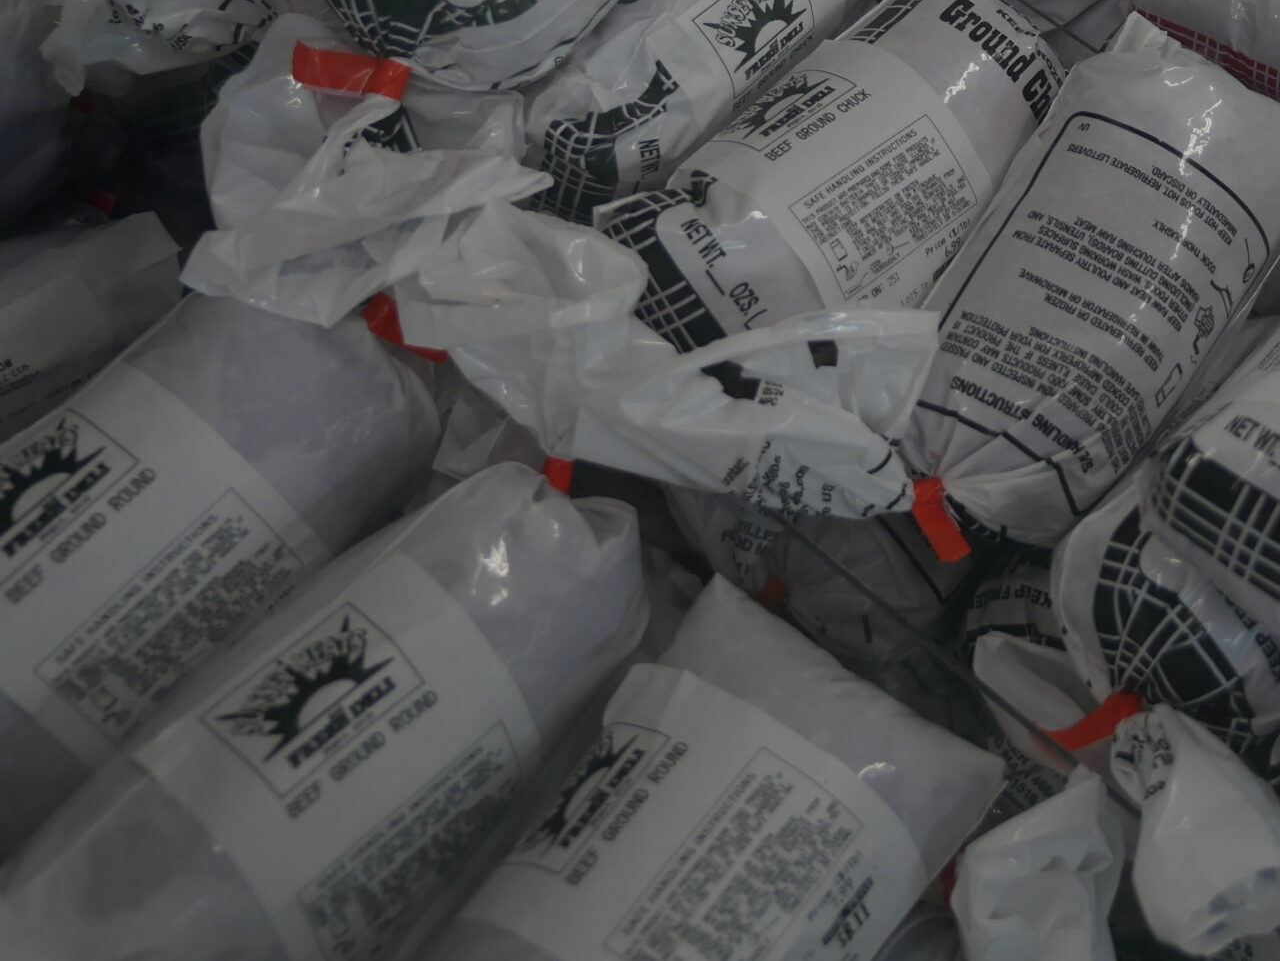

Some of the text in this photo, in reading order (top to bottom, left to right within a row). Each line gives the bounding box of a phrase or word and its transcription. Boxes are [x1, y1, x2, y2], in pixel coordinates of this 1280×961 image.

[764, 85, 872, 164] BEEF GROUND CHUCK
[637, 137, 662, 161] NET
[803, 124, 919, 210] SAFE HANDLING INSTRUCTIONS
[1066, 134, 1235, 245] KEEP HOT REFRIGERATE LEFTOVERS
[1146, 163, 1243, 235] IMMEDIATELY OR DISCARD.
[678, 213, 713, 248] NET
[924, 236, 947, 256] Price
[940, 237, 965, 258] 6.99
[1025, 208, 1159, 280] CUTTING AND
[1095, 226, 1117, 244] RAW
[1115, 236, 1158, 266] TOUCHING
[695, 236, 729, 269] WT.
[1037, 222, 1191, 322] OTHER WASH WORKING SURFACES
[1155, 261, 1182, 283] AFTER
[1196, 251, 1219, 273] COOK
[1011, 226, 1185, 332] KEEP RAW AND POULTRY SEPARATE FROM
[1065, 292, 1081, 306] OR
[1175, 278, 1204, 302] HANDS
[1078, 296, 1142, 340] REFRIGERATOR
[965, 320, 1099, 396] CAUSE THE PRODUCT
[1009, 330, 1033, 349] YOUR
[1074, 308, 1162, 372] KEEP OR
[939, 337, 1097, 426] PREPARED INSPECTED AND PASSED
[980, 342, 1045, 383] PRODUCTS MAY
[1085, 353, 1129, 387] HANDLING
[1224, 408, 1261, 445] NET
[46, 462, 159, 567] GROUND ROUND
[324, 725, 389, 786] GROUND
[385, 683, 442, 737] ROUND
[595, 735, 691, 844] GROUND ROUND
